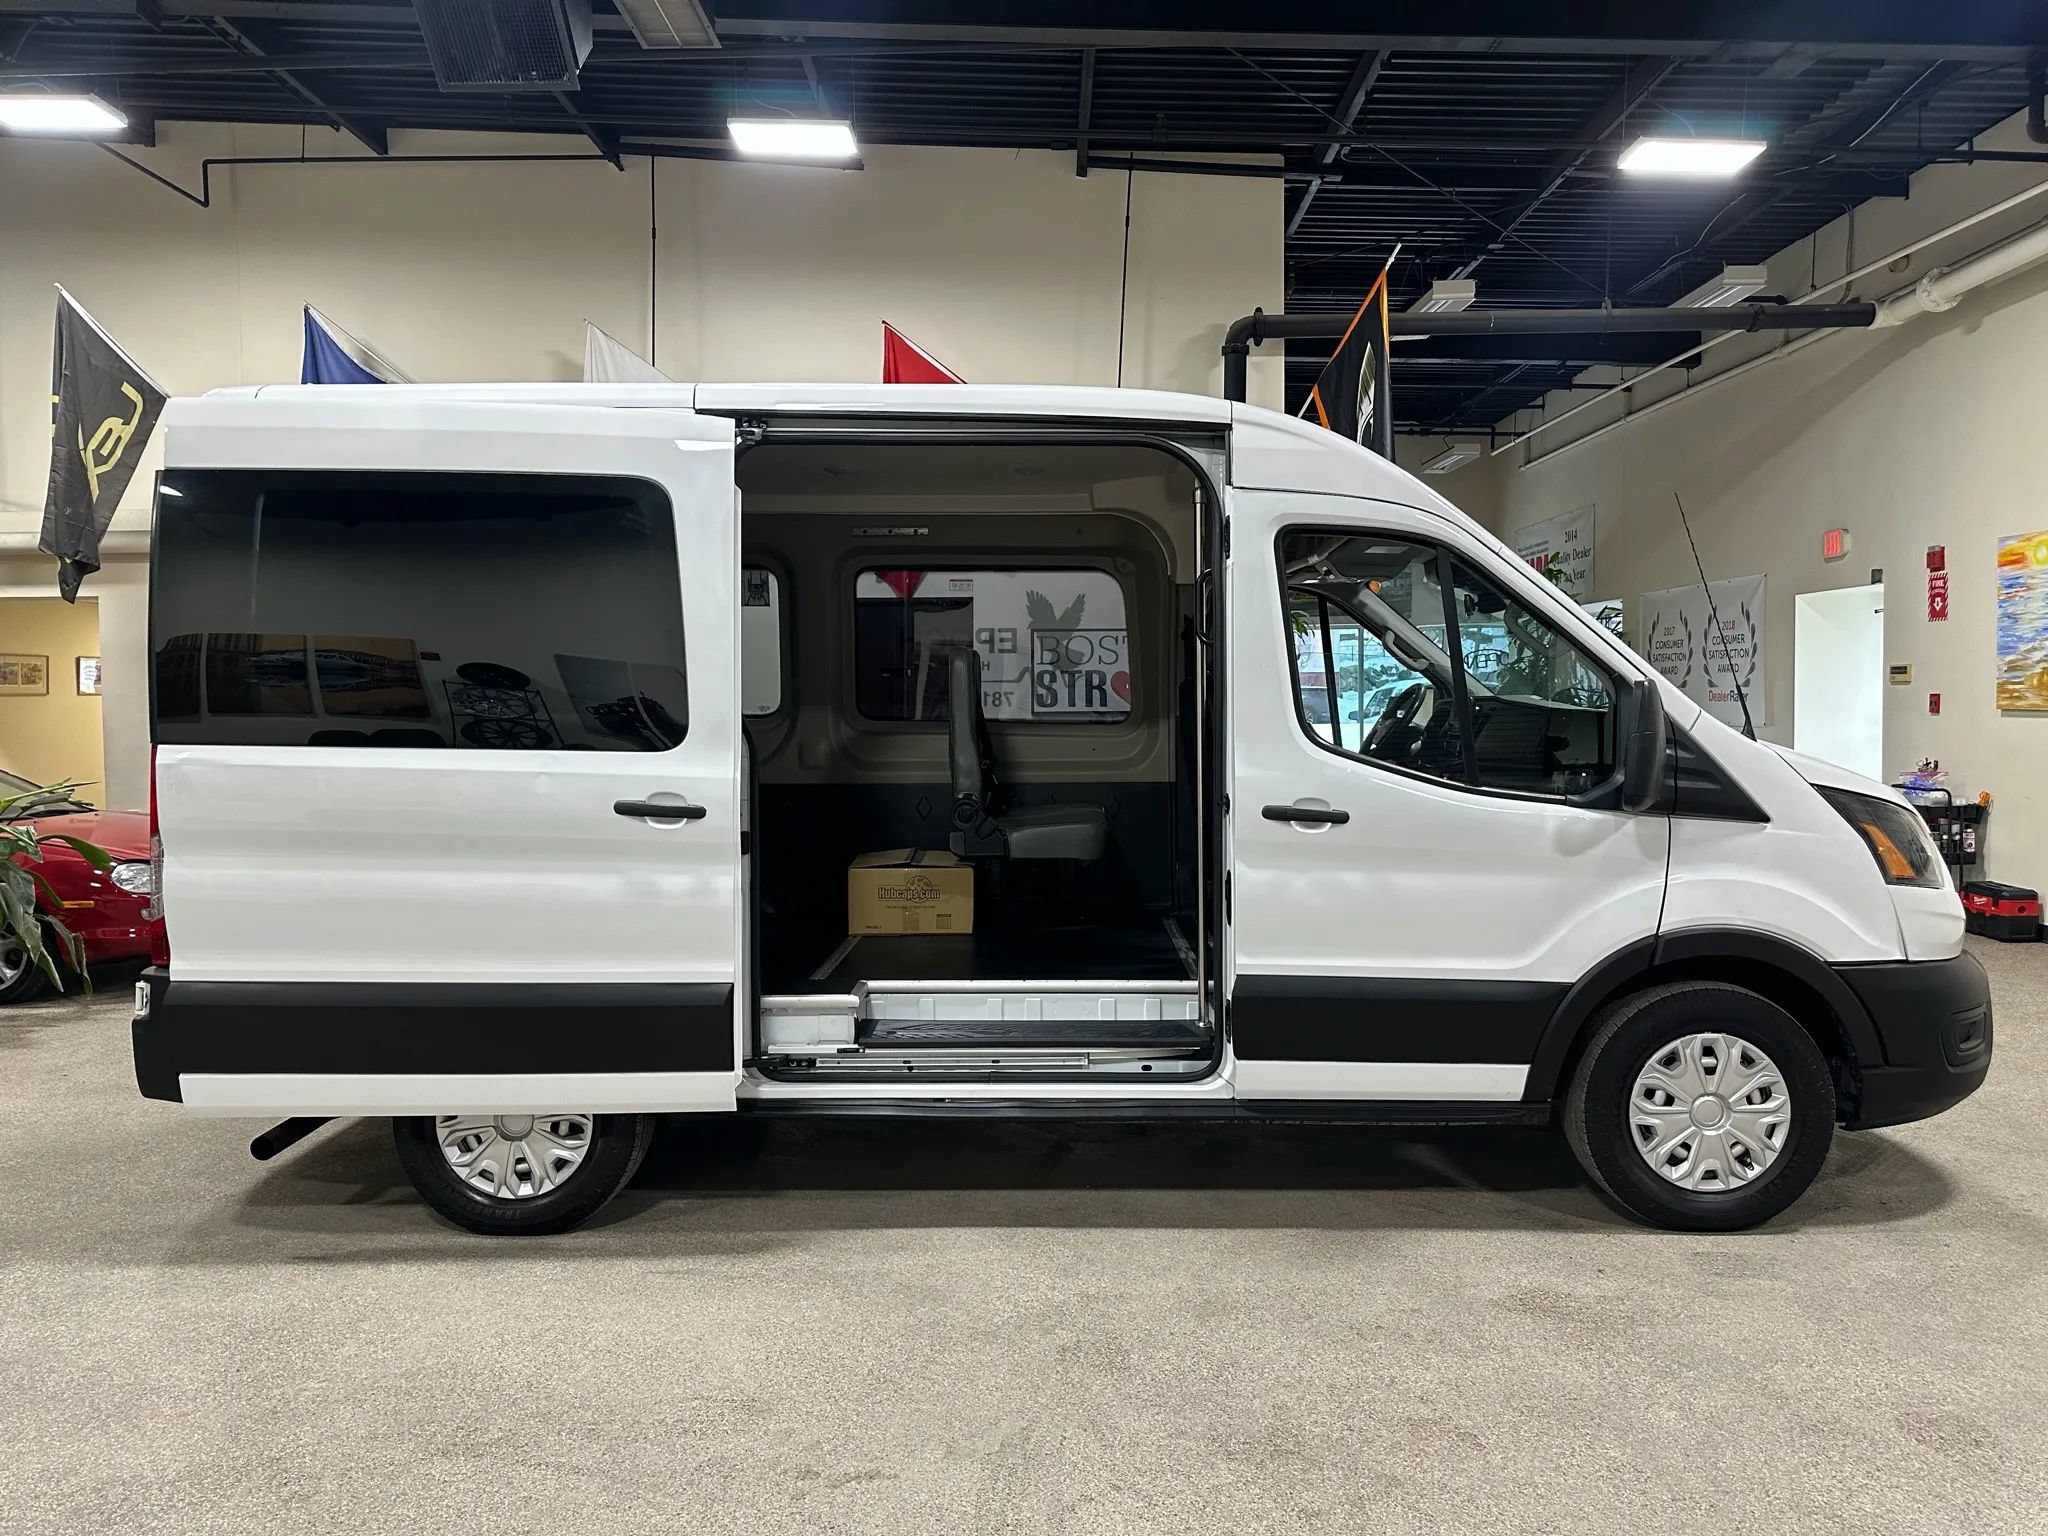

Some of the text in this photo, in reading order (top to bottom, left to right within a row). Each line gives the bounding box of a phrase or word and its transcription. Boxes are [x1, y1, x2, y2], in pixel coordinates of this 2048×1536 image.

[1564, 528, 1577, 543] 2014
[1572, 546, 1591, 561] Dealer
[1572, 569, 1586, 580] Year
[1932, 579, 1944, 588] FIRE
[1663, 626, 1675, 636] 2017
[1722, 620, 1736, 631] 2018
[1036, 634, 1128, 665] BOS
[1655, 639, 1684, 650] CONSUMER
[1652, 653, 1687, 663] SATISFACTION
[1660, 665, 1679, 675] AWARD
[1708, 689, 1749, 703] DealerRaer
